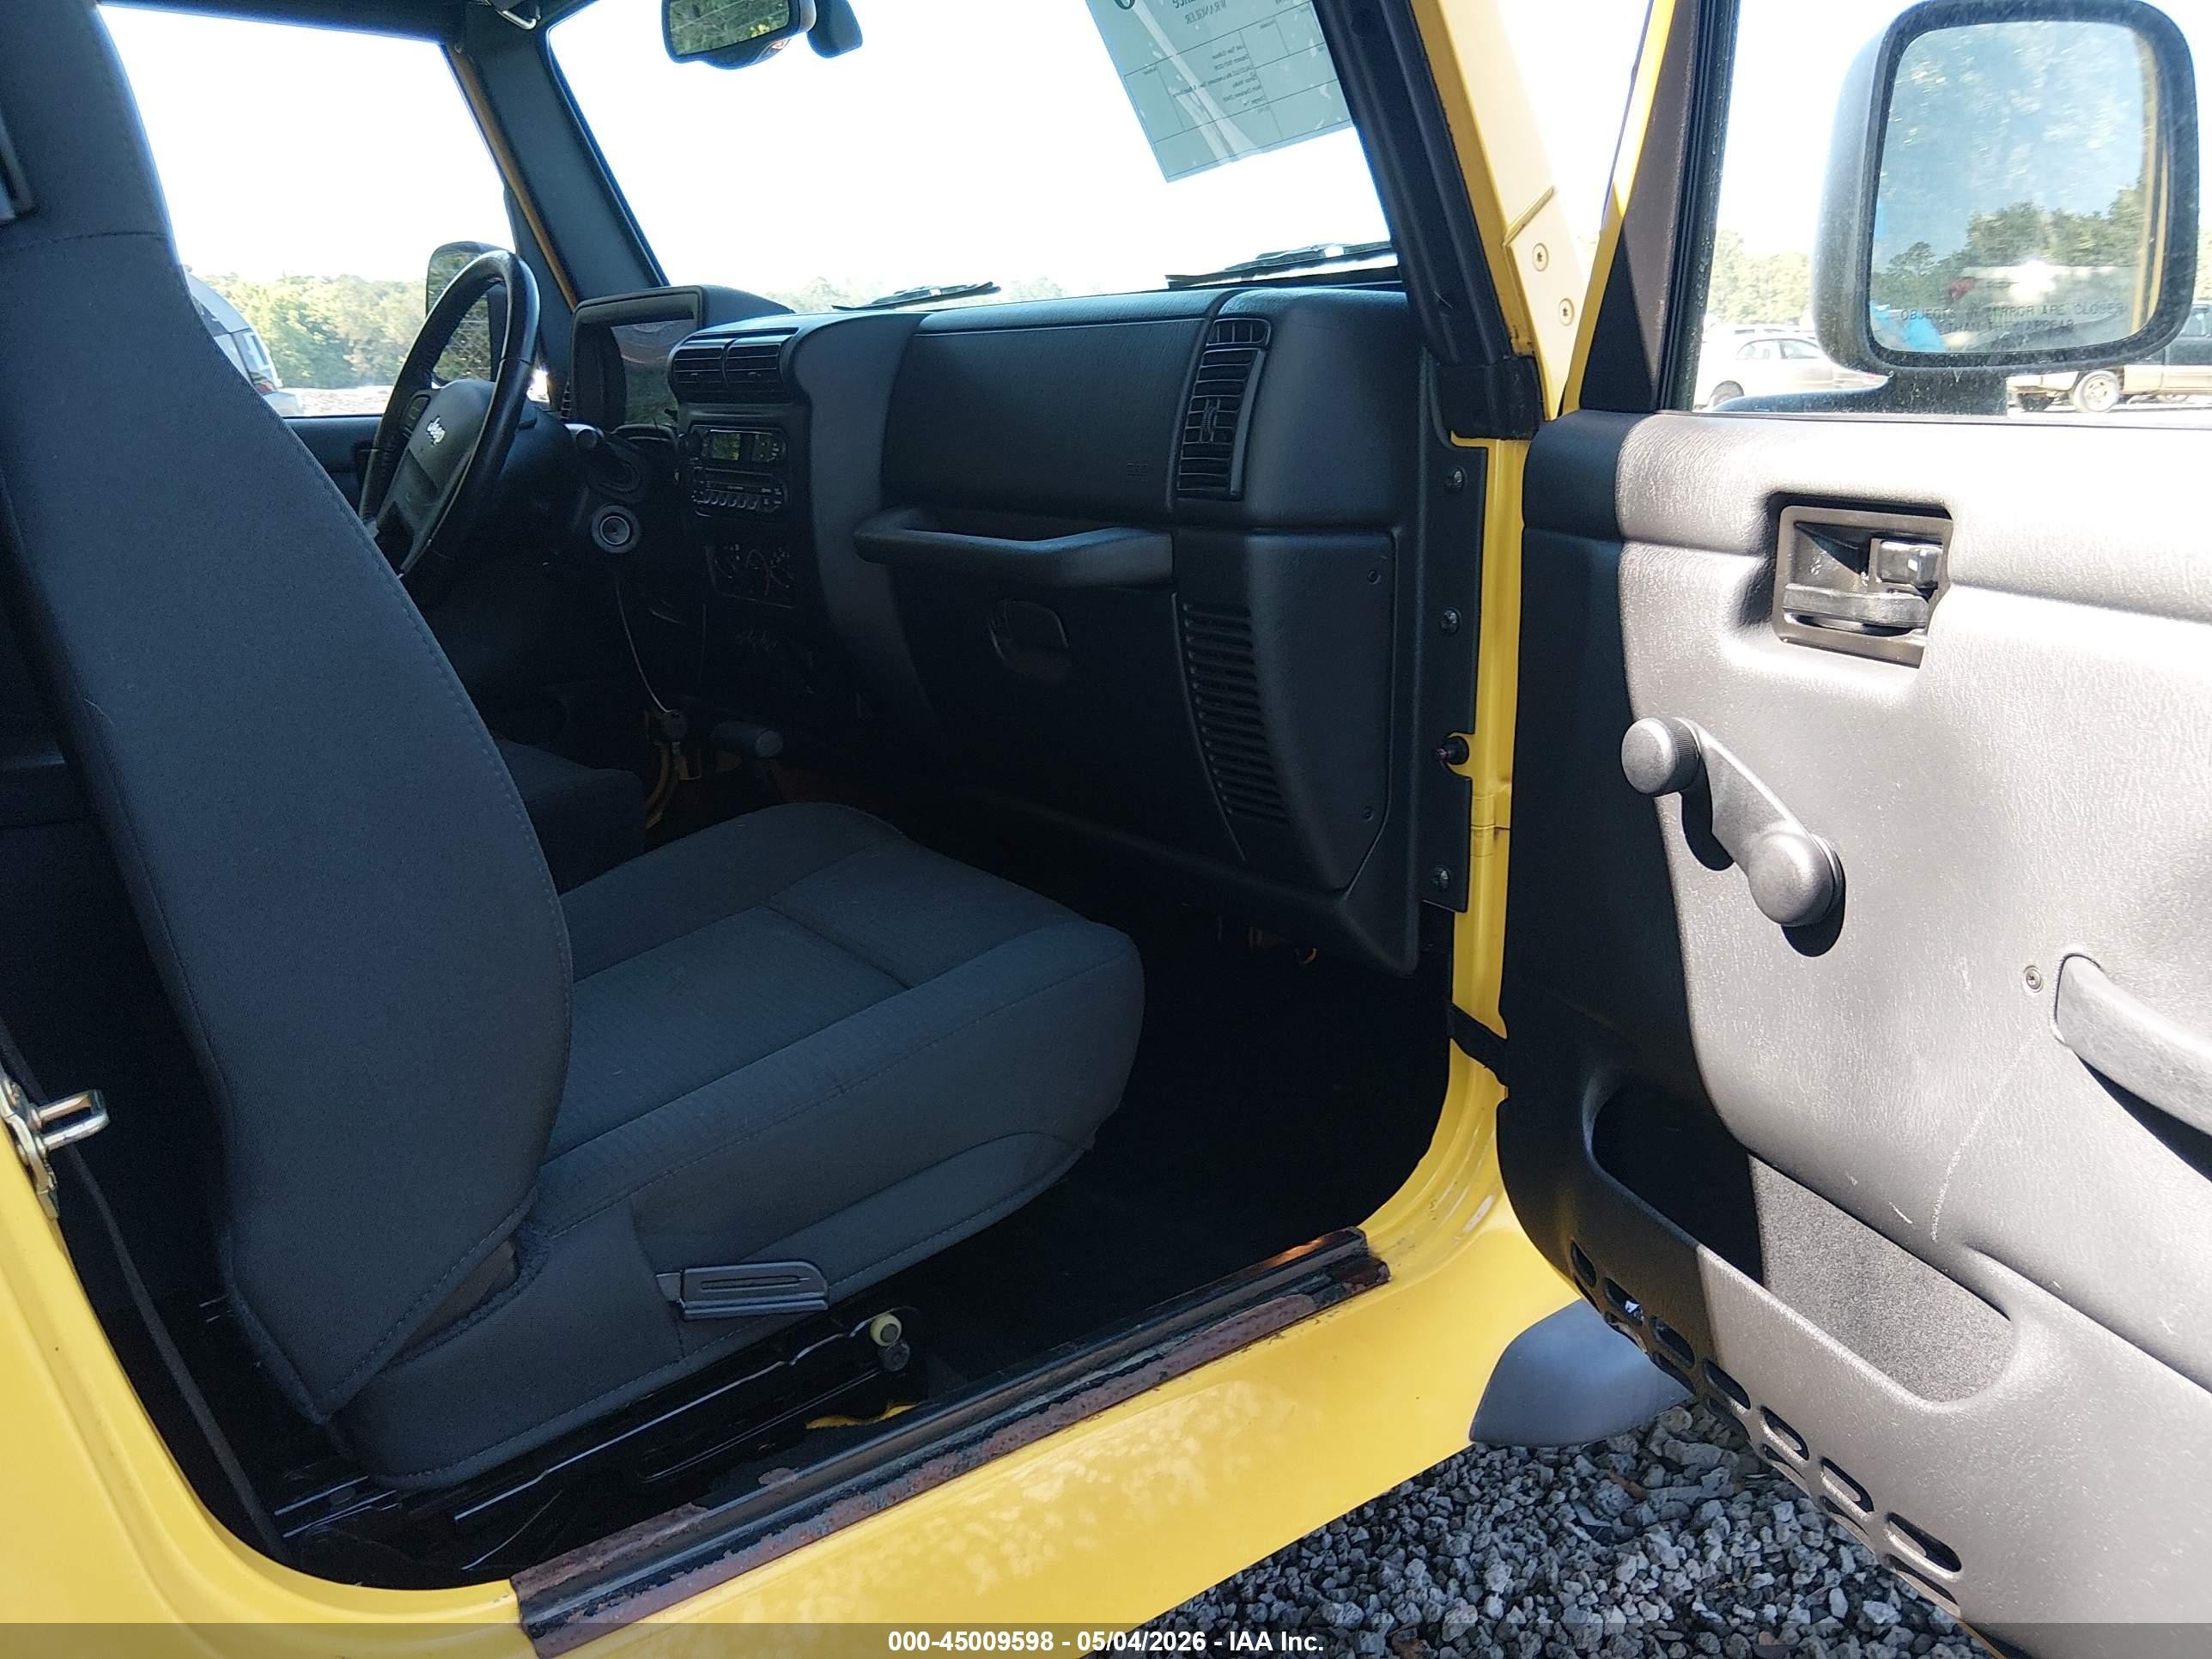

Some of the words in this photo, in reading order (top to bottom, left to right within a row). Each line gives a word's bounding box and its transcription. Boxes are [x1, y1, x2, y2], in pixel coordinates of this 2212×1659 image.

[1900, 308, 1956, 321] OBJECTS
[2041, 304, 2066, 316] ARE
[2074, 302, 2124, 316] CLOSER
[2026, 319, 2075, 330] APPEAR
